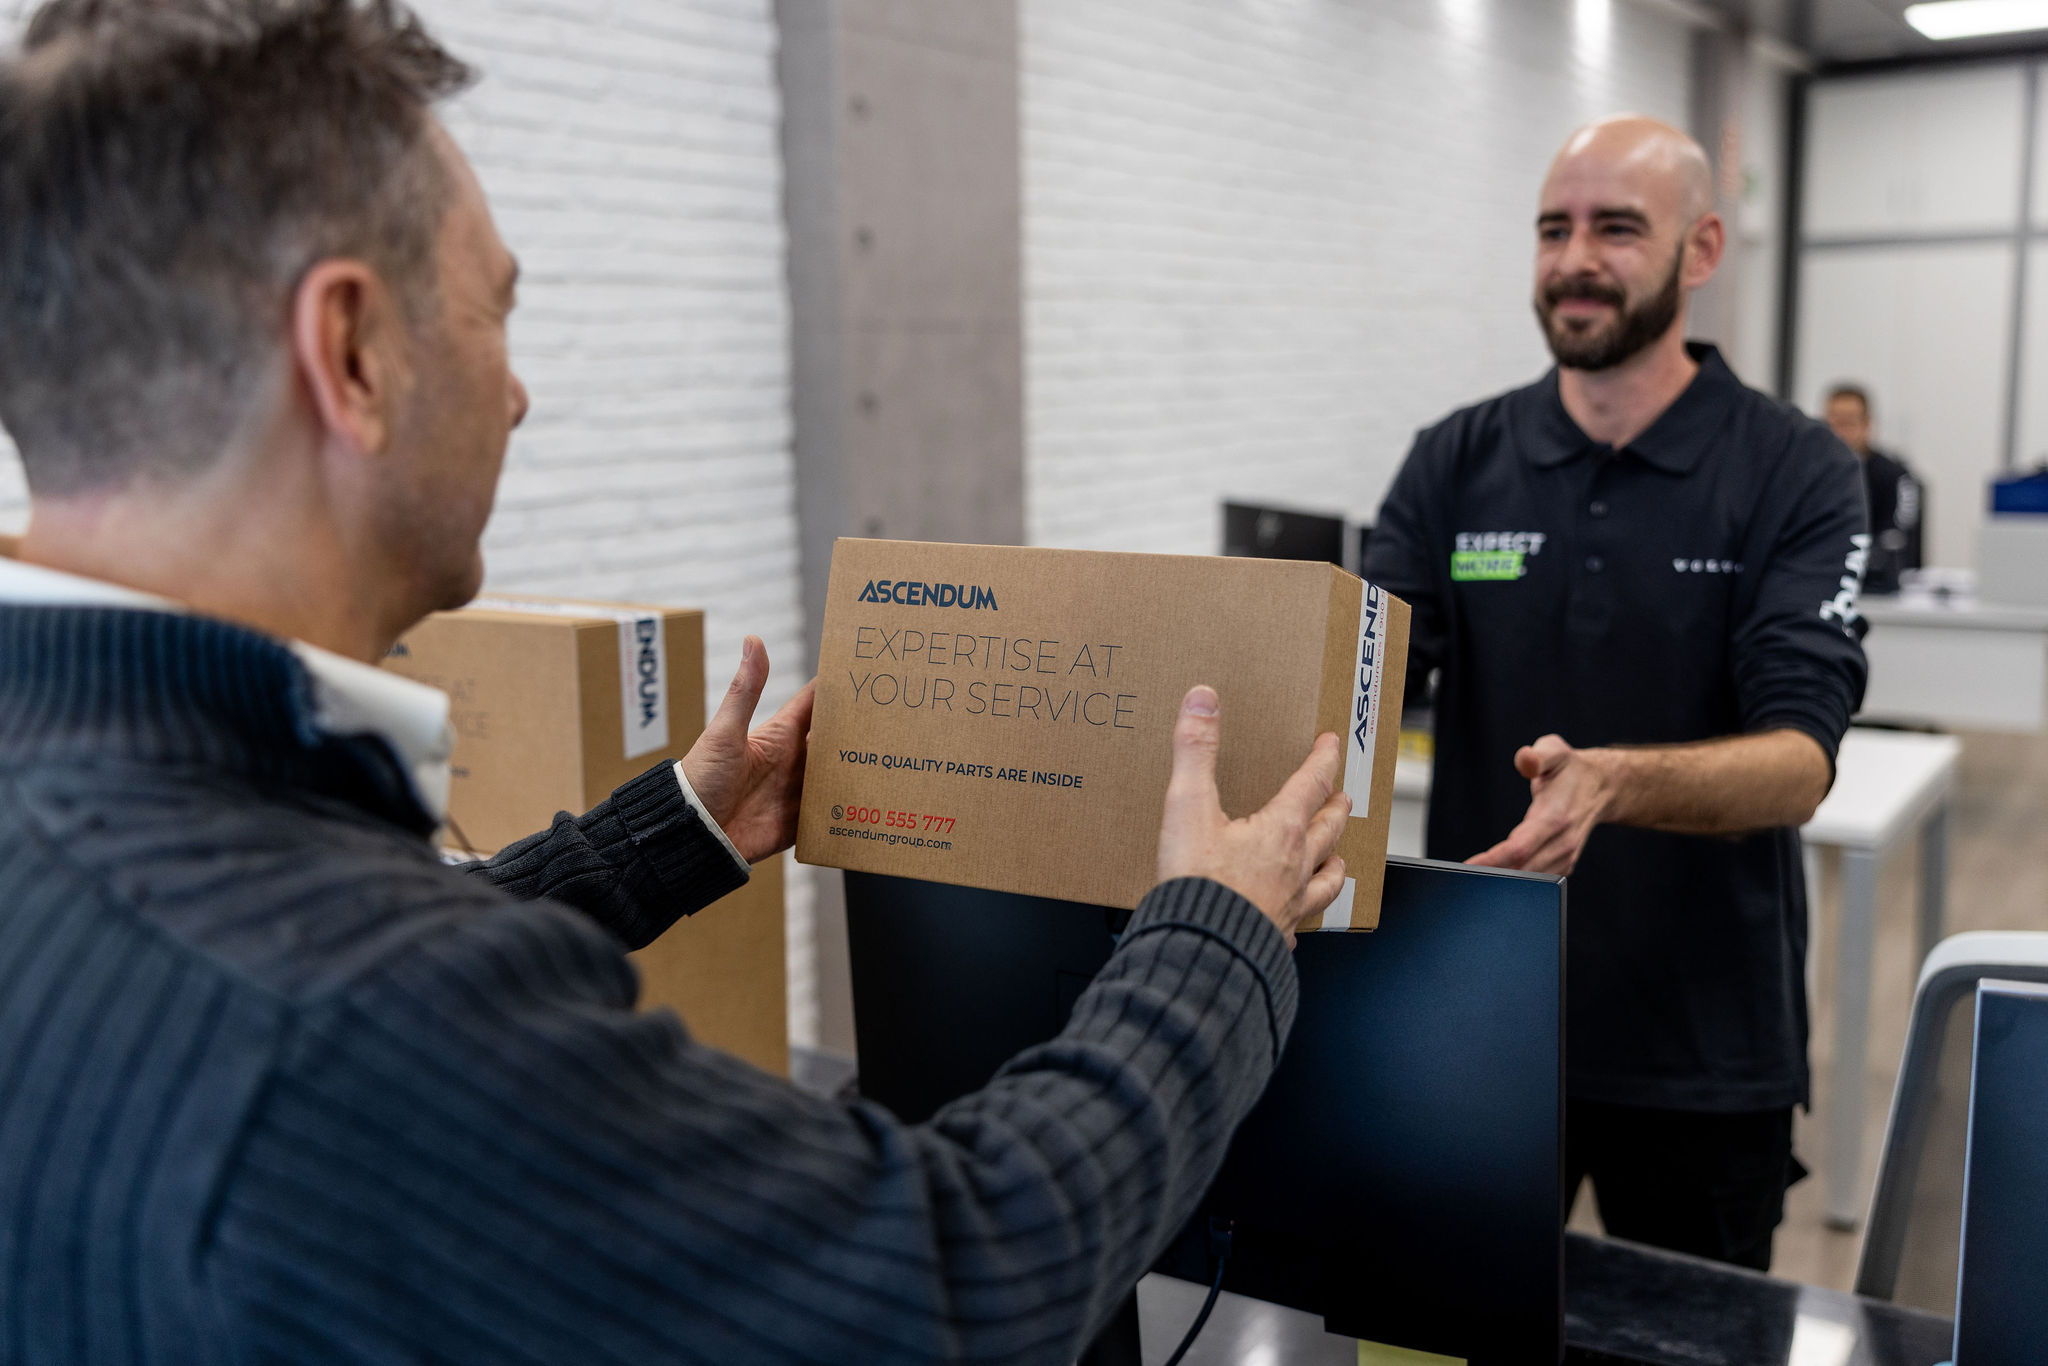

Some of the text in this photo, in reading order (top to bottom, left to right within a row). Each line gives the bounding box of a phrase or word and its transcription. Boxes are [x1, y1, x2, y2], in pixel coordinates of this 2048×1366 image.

[1455, 532, 1547, 555] EXPECT
[857, 579, 999, 611] ASCENDUM
[855, 626, 1123, 678] EXPERTISE AT
[849, 671, 1138, 728] YOUR SERVICE
[839, 750, 1084, 789] YOUR QUALITY PARTS ARE INSIDE
[845, 805, 956, 834] 900 555 777
[829, 826, 953, 850] ascendumgroup.com
